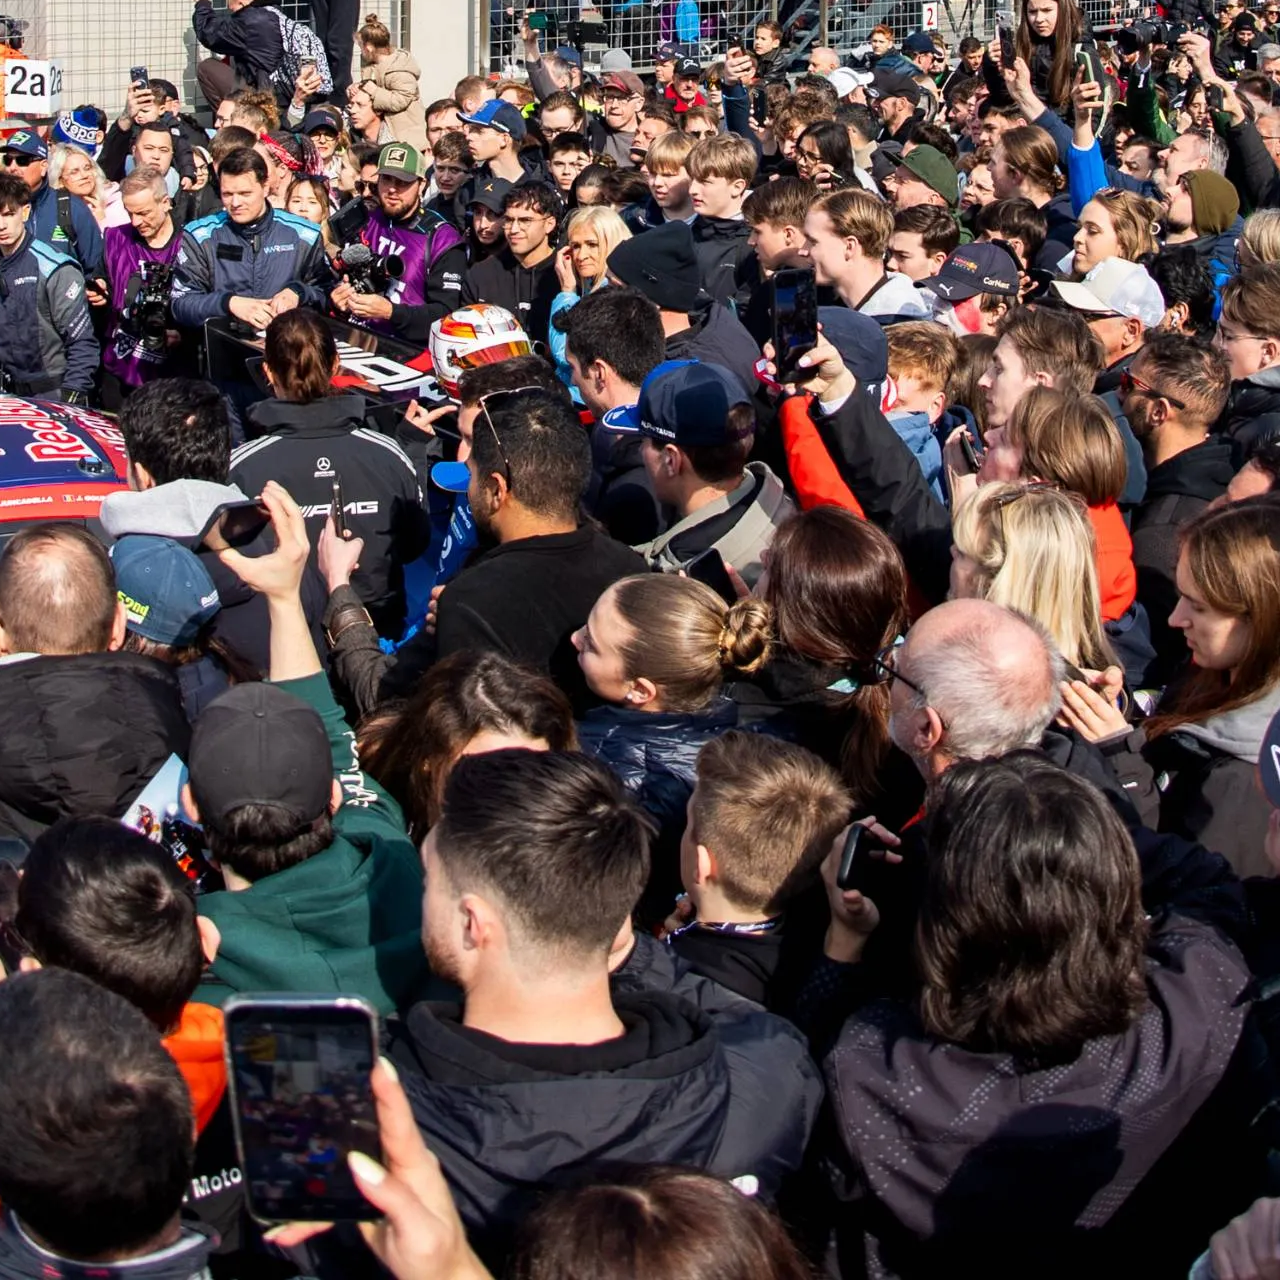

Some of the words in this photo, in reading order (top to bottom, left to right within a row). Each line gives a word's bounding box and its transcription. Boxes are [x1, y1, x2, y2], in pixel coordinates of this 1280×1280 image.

[926, 7, 934, 26] 2
[10, 65, 47, 97] 2a
[191, 1167, 243, 1199] Moto
